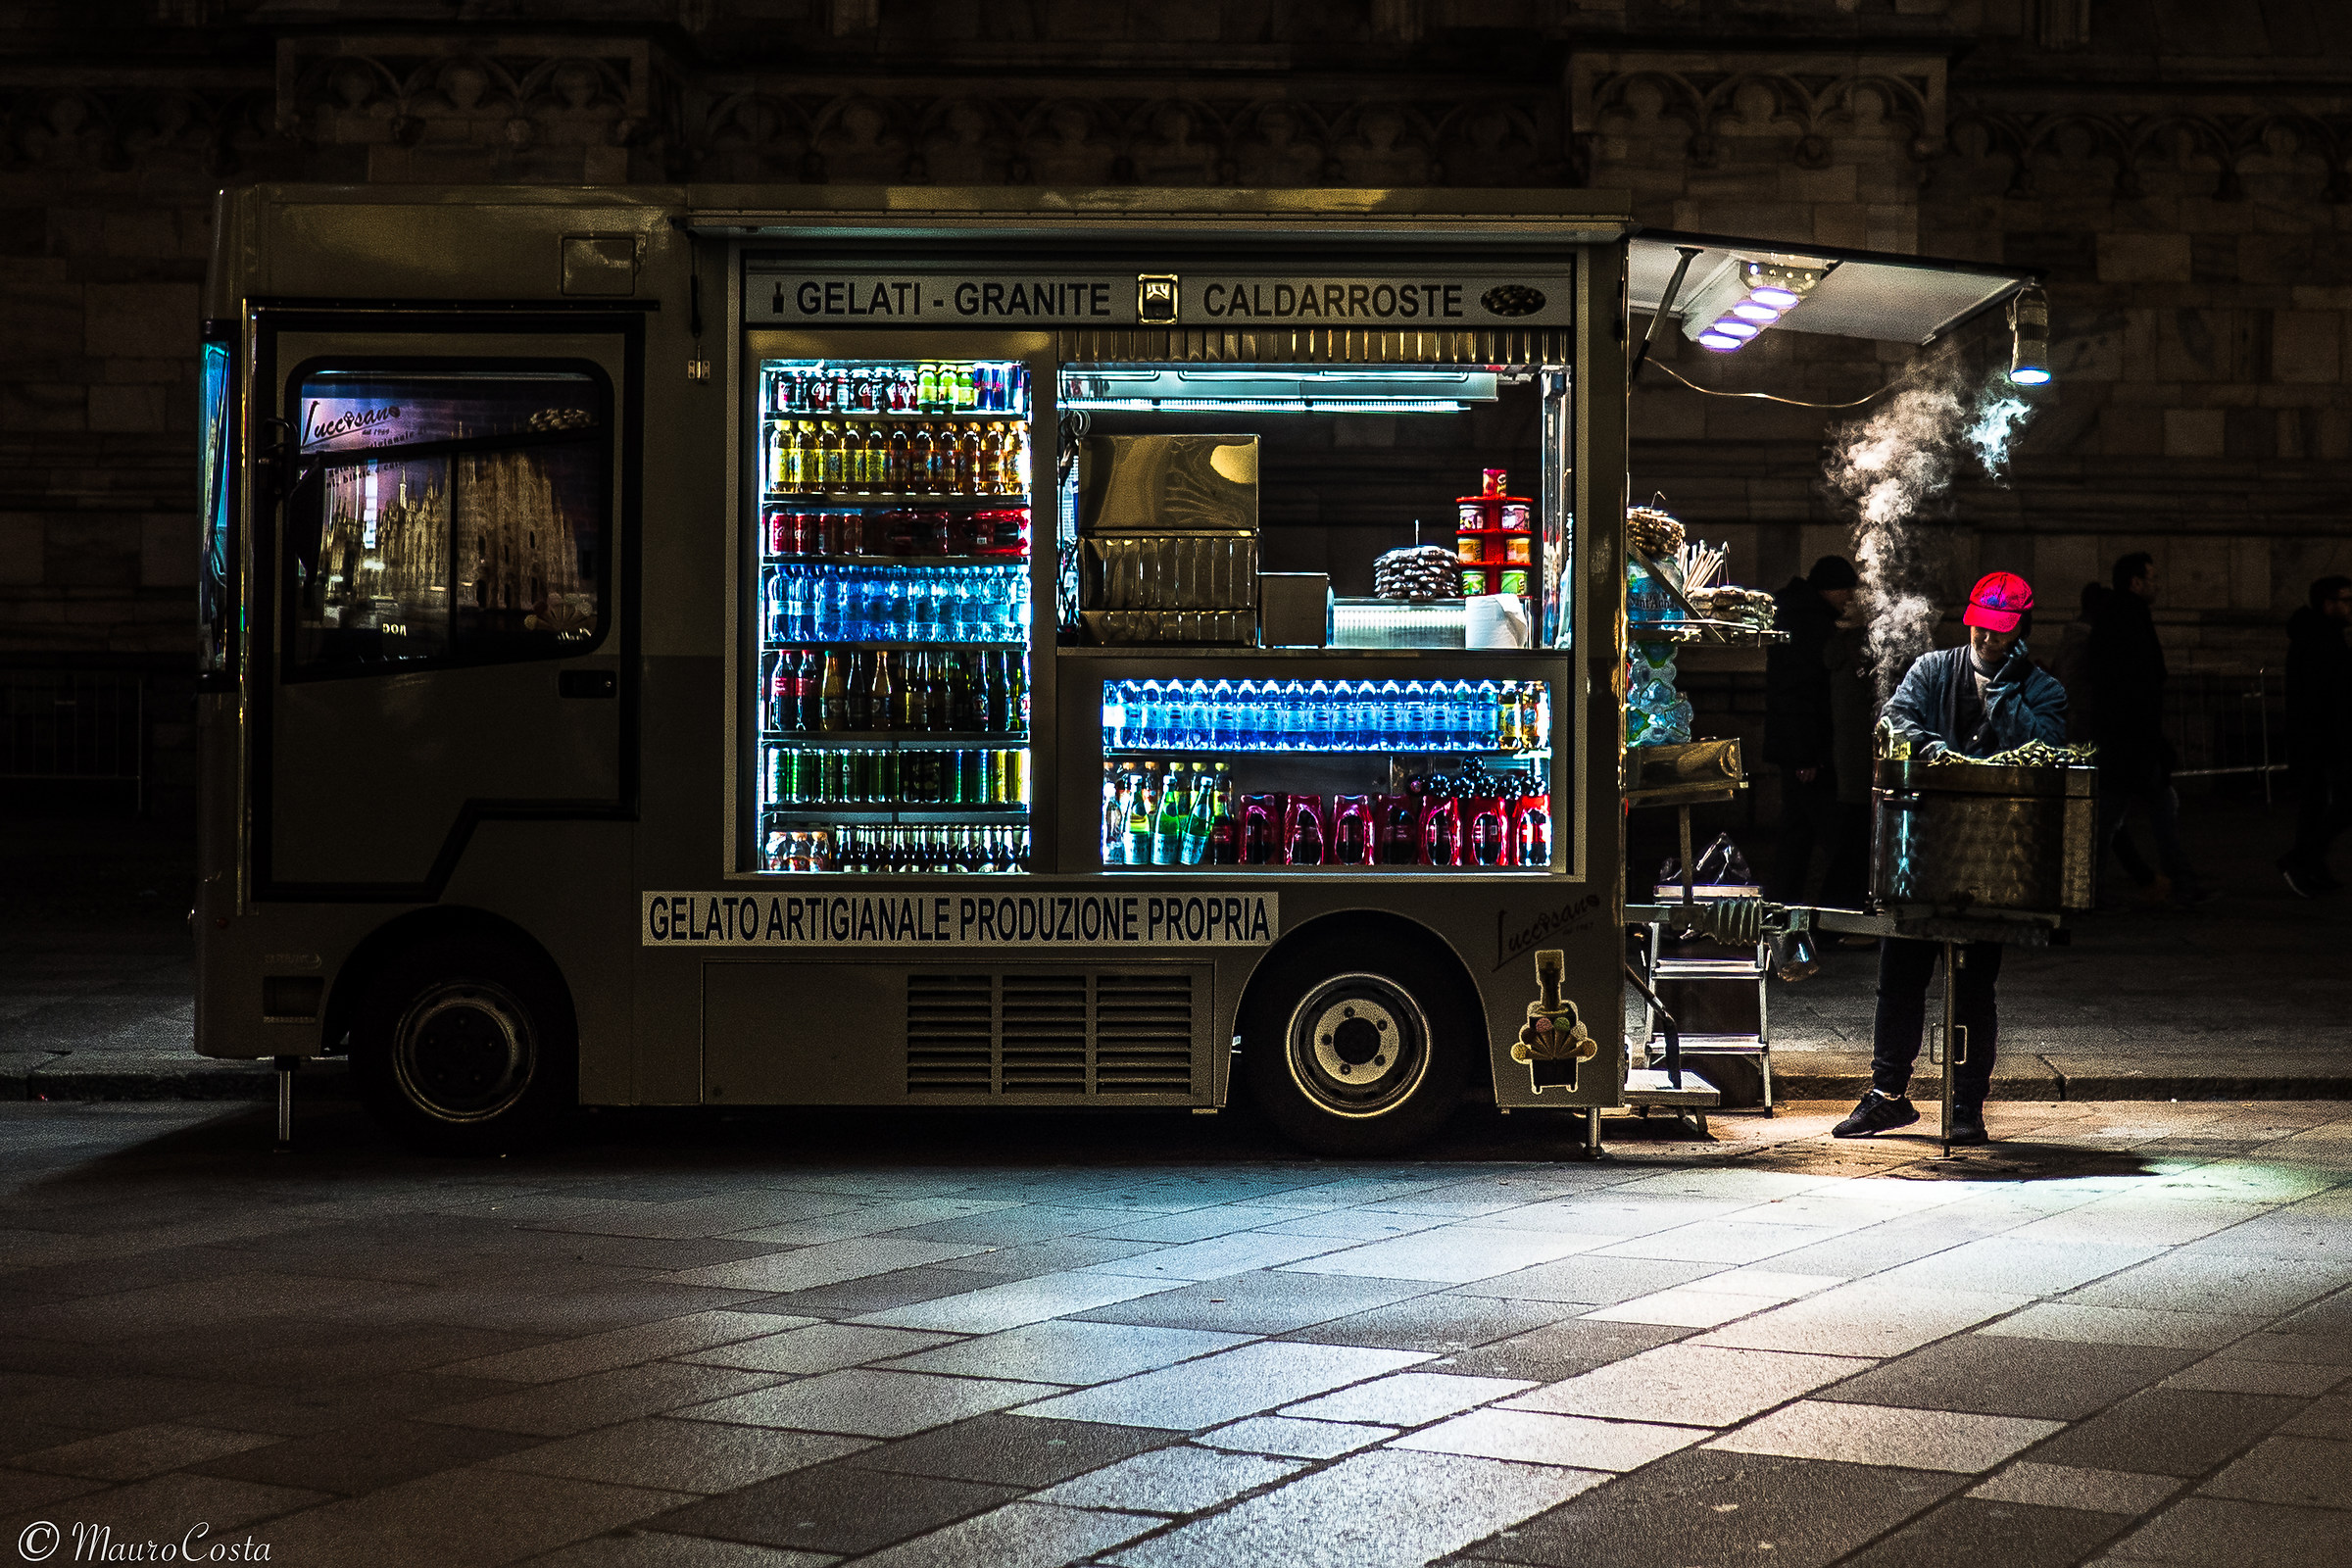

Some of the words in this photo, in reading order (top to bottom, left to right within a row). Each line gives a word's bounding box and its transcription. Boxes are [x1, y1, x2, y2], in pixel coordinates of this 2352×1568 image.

[796, 281, 922, 317] GELATI
[953, 281, 1111, 317] GRANITE
[1202, 282, 1463, 318] CALDARROSTE
[649, 896, 760, 942] GELATO
[765, 896, 951, 942] ARTIGIANALE
[959, 896, 1138, 942] PRODUZIONE
[1149, 896, 1270, 942] PROPRIA
